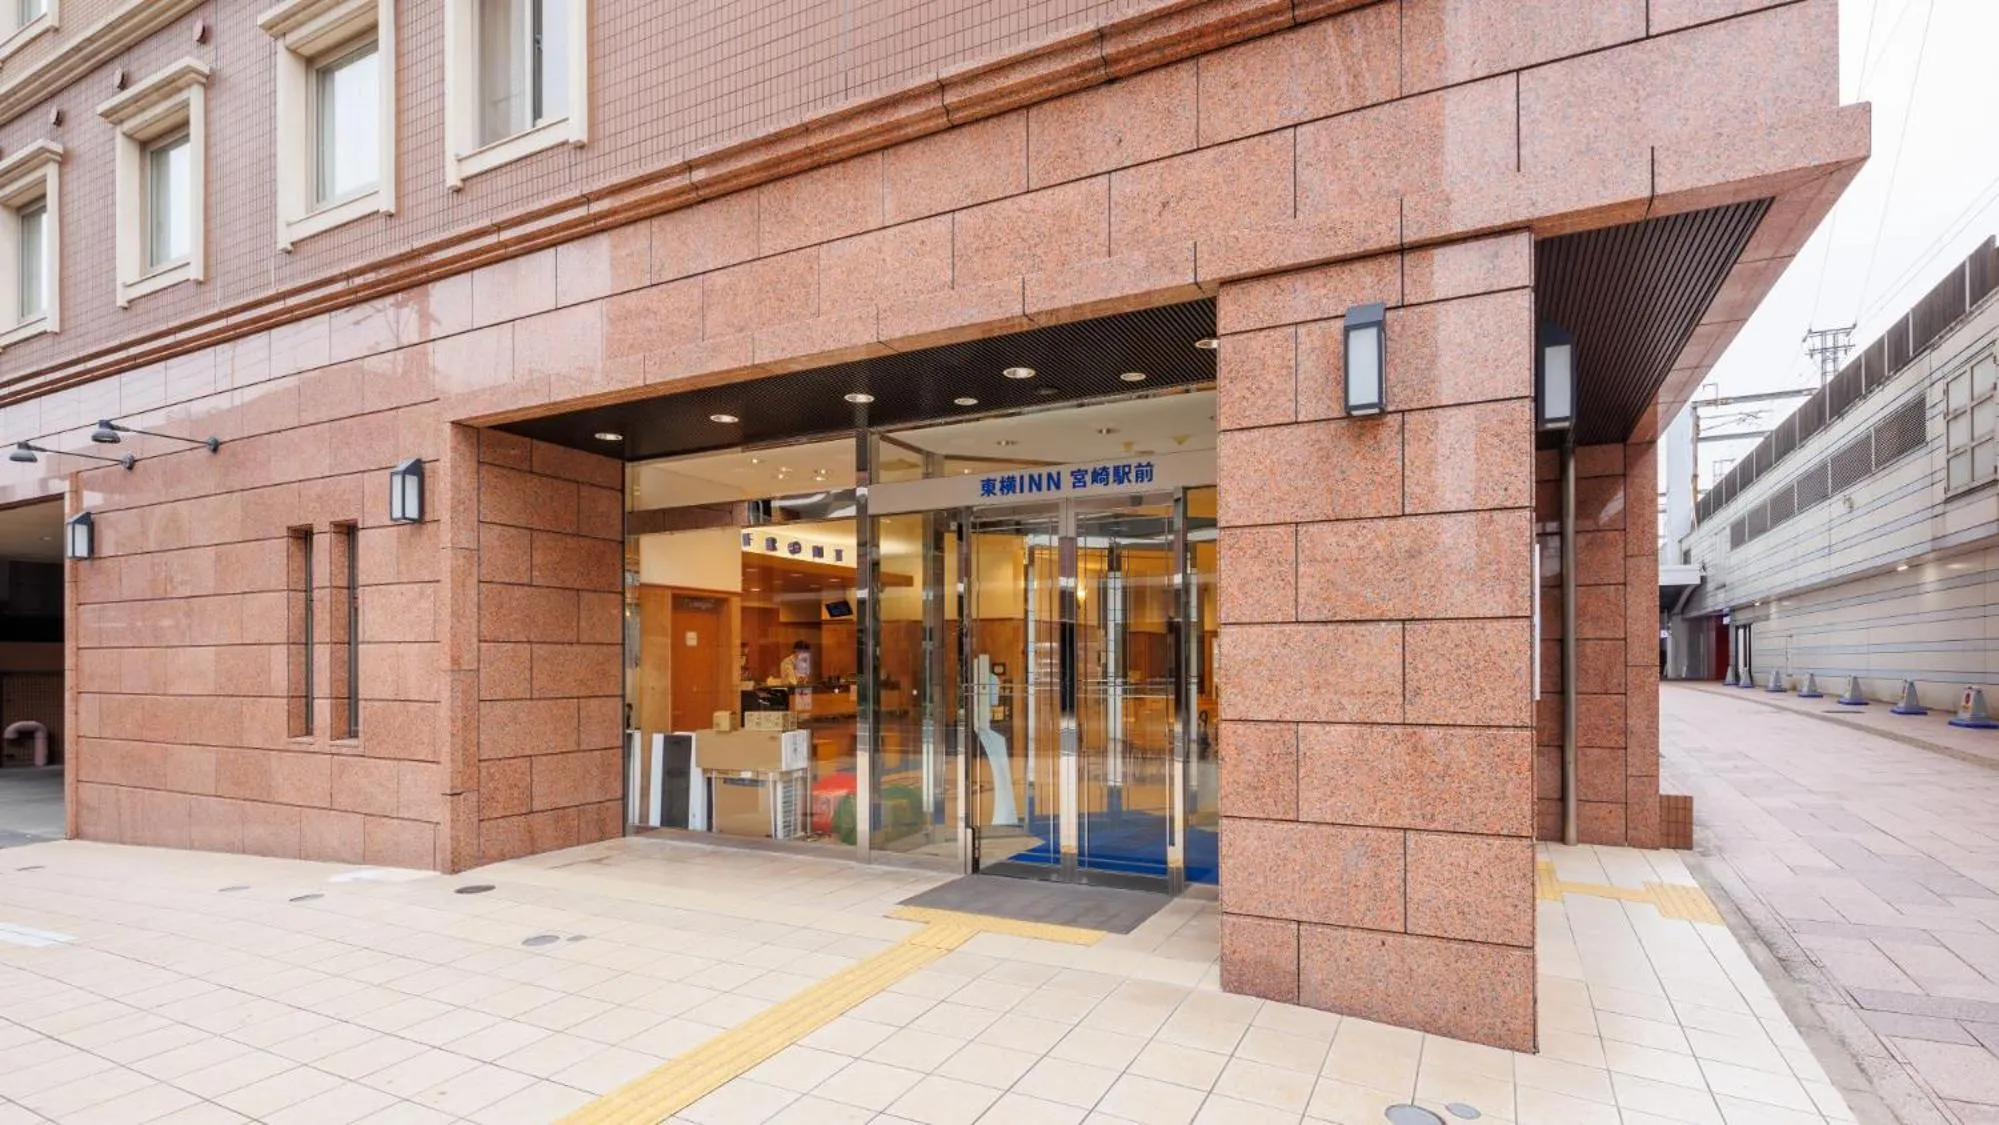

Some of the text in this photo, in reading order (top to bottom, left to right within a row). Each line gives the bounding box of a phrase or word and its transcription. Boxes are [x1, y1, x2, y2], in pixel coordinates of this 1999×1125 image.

[980, 462, 1154, 497] 東横INN 宮崎駅前
[742, 532, 843, 562] FRONT
